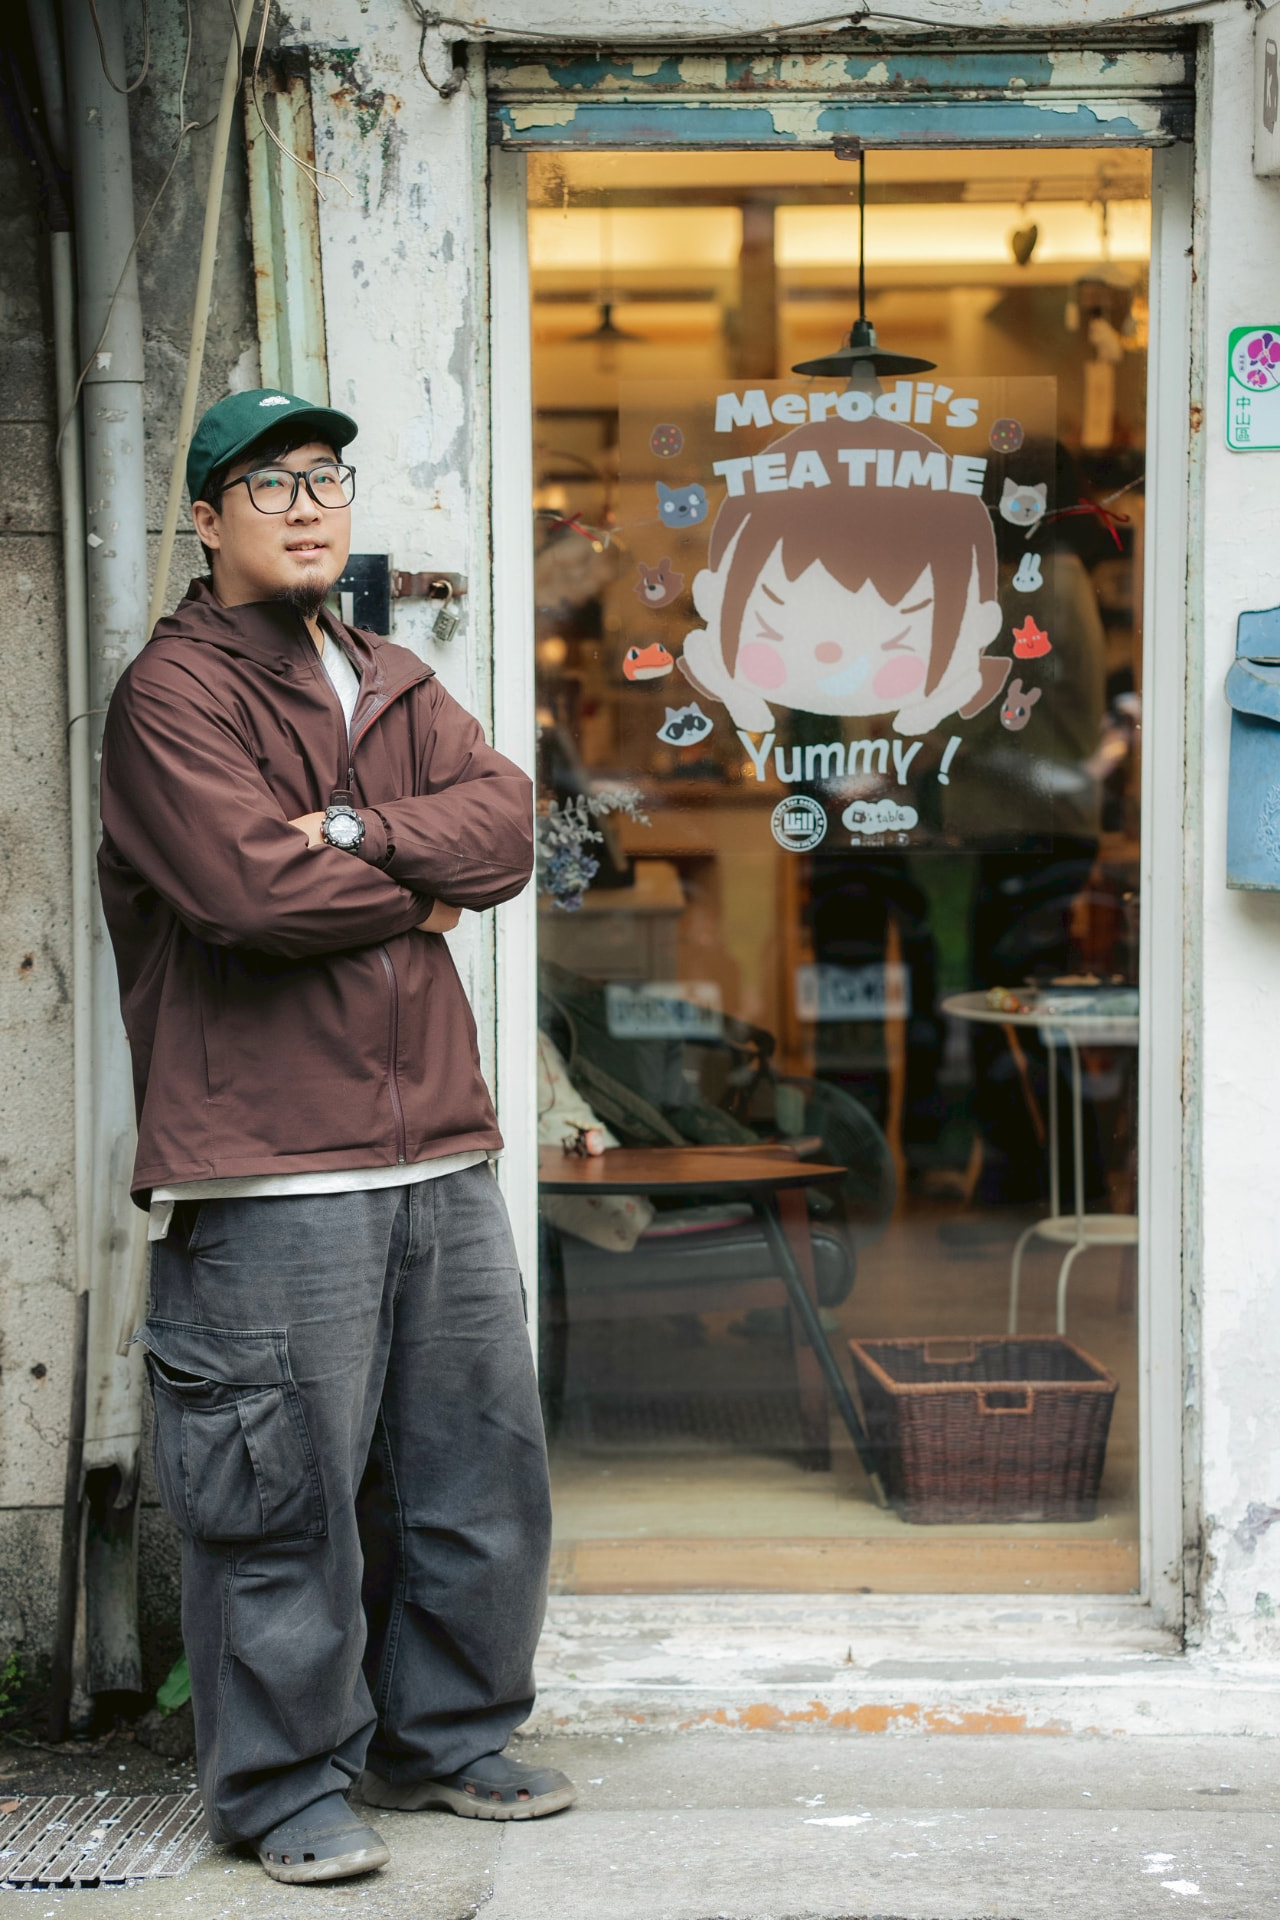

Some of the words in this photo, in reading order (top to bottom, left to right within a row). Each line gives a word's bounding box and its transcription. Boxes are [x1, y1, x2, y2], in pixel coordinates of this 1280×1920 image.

[714, 381, 979, 432] Merodi's
[1236, 396, 1251, 442] 中山區
[713, 450, 831, 497] TEA
[838, 449, 988, 496] TIME
[736, 731, 924, 785] Yummy
[875, 810, 904, 823] table
